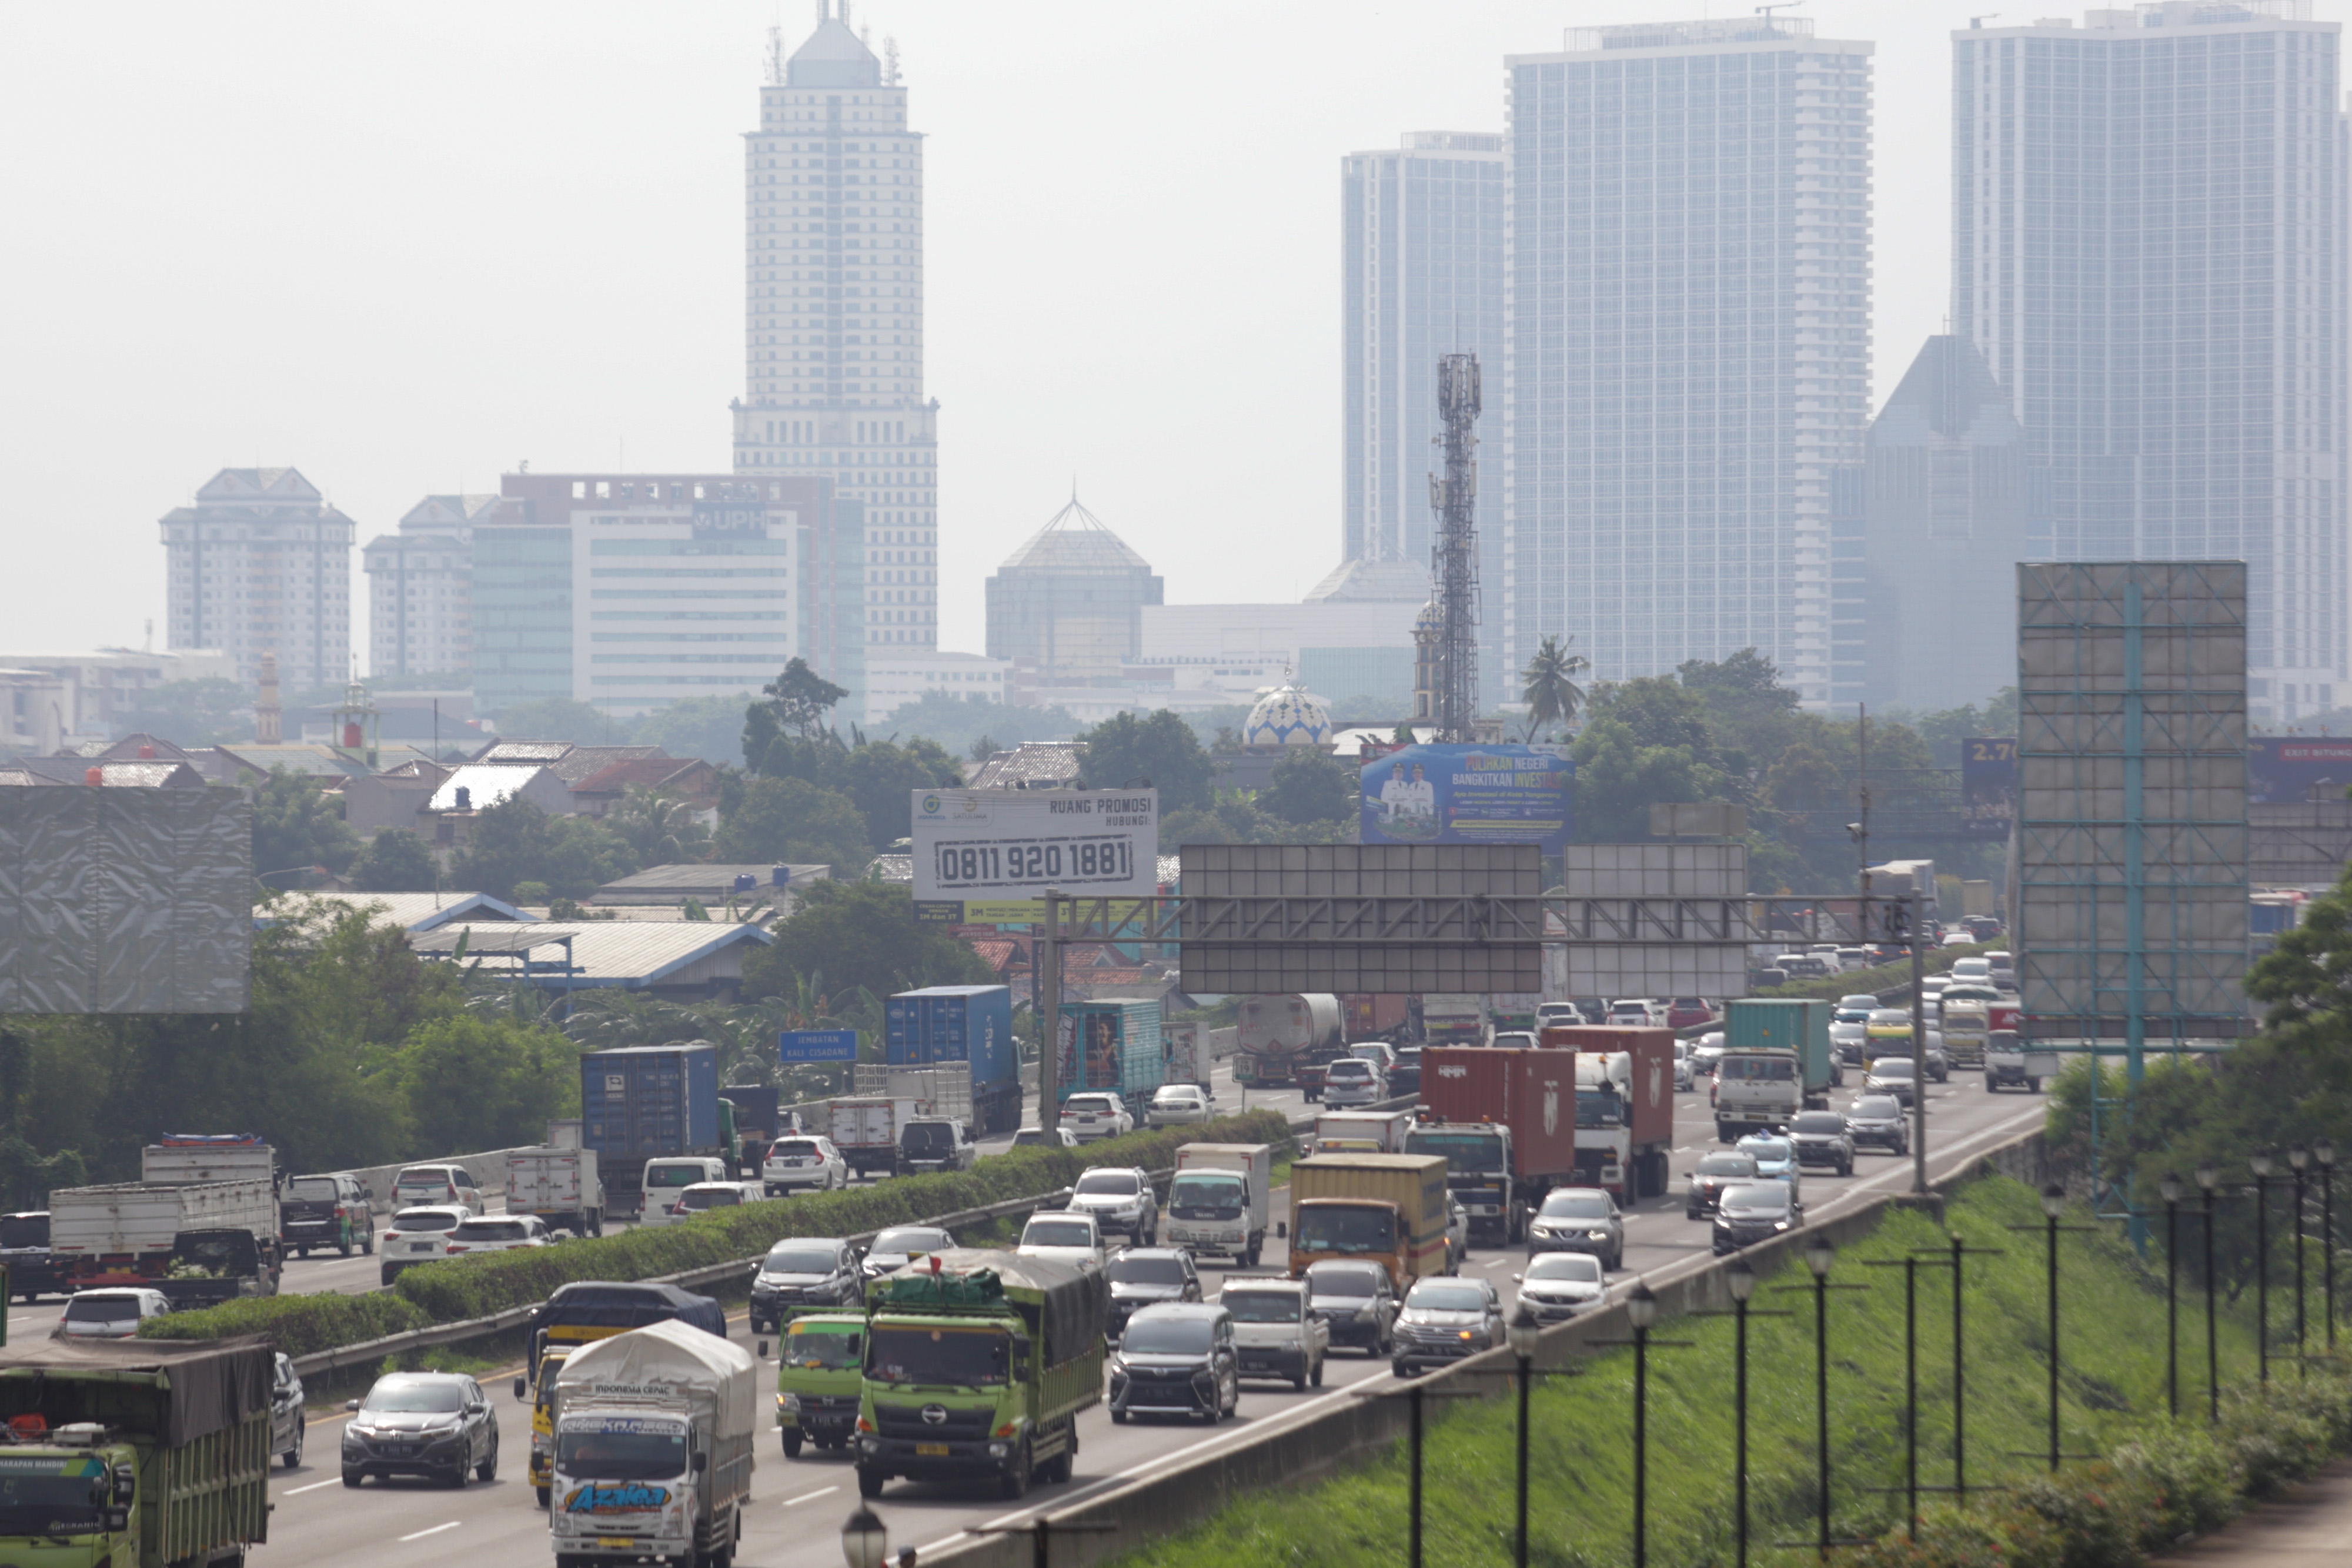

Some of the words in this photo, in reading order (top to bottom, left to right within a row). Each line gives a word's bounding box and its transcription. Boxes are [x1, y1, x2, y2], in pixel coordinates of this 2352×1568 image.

[714, 510, 766, 530] UPH
[2284, 748, 2308, 757] EXIT
[1466, 755, 1513, 771] PULIHKAN
[1515, 757, 1548, 770] NEGERI
[1452, 773, 1512, 787] BANGKITKAN
[1050, 800, 1091, 814] RUANG
[1097, 797, 1151, 814] PROMOSI
[1106, 815, 1151, 827] HUBUNGI:
[942, 847, 999, 881] 0811
[1008, 845, 1061, 878] 920
[1069, 841, 1127, 876] 1881
[971, 908, 984, 917] 3M
[798, 1036, 839, 1044] JEMBATAN
[787, 1049, 804, 1057] KALI
[809, 1048, 848, 1057] CISADANE
[1241, 1065, 1250, 1073] 19
[1438, 1065, 1466, 1078] HMM
[595, 1385, 641, 1394] INDONESIA
[35, 1460, 67, 1468] MANDIRI
[566, 1485, 667, 1512] Azalea
